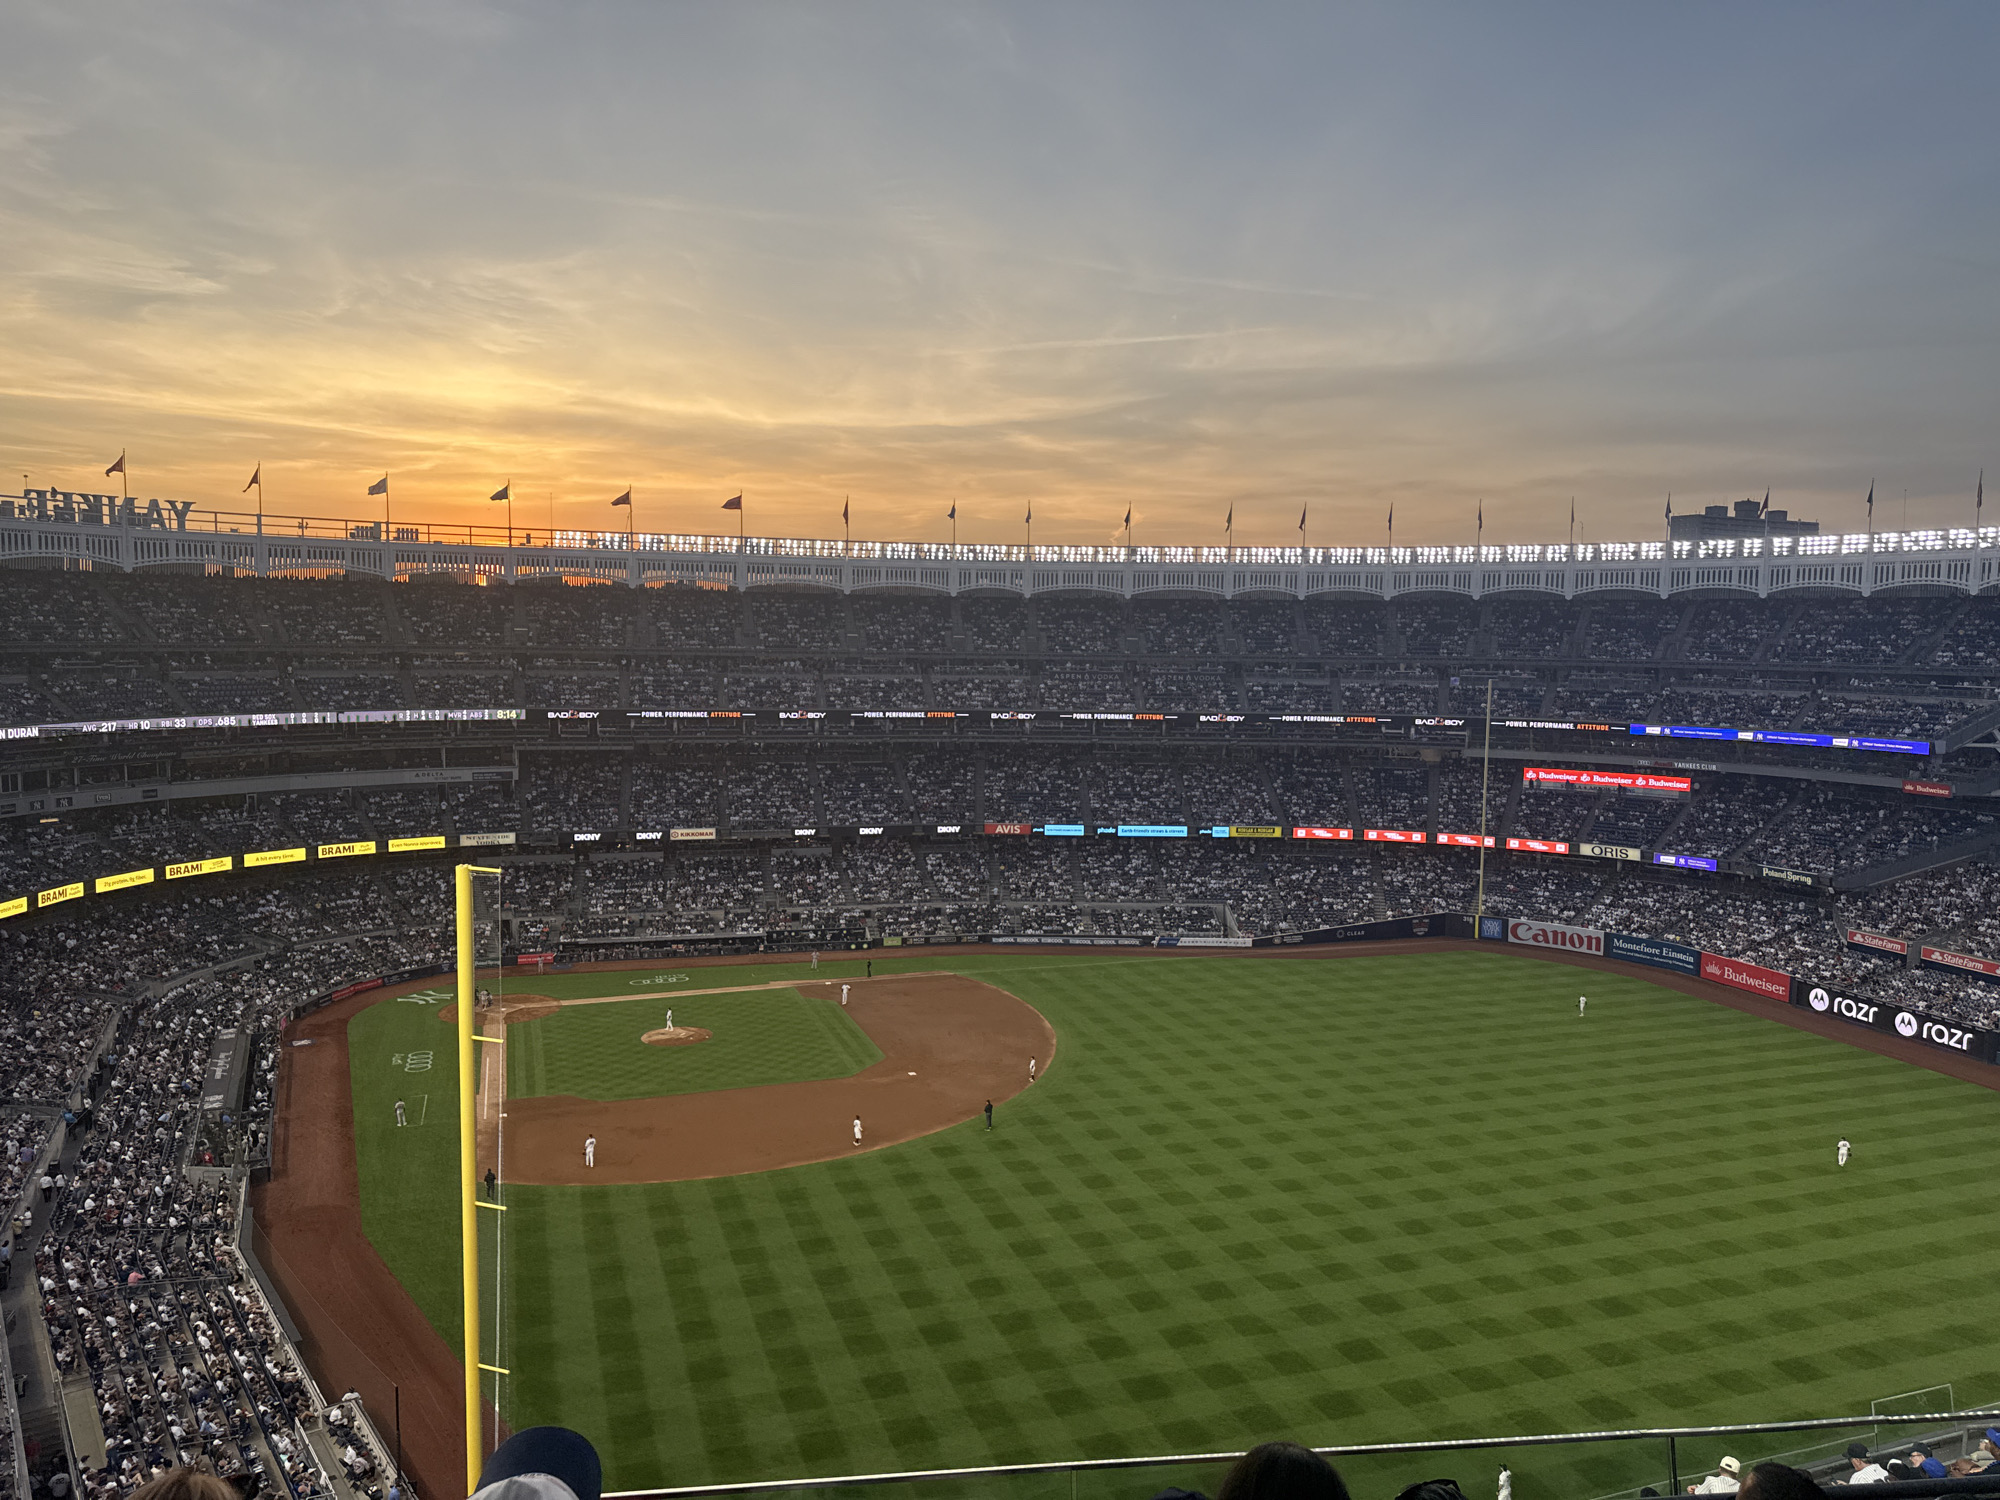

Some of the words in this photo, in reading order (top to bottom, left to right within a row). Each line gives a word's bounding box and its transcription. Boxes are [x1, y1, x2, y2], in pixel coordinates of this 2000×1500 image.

[215, 716, 236, 726] .685
[497, 710, 516, 719] 8:14
[99, 722, 116, 732] .217
[140, 720, 150, 730] 10
[174, 718, 186, 728] 33
[8, 726, 39, 739] DURAN
[1539, 771, 1577, 781] Budweiser
[1593, 775, 1633, 785] Budweiser
[1648, 778, 1688, 788] Budweiser
[1916, 785, 1949, 794] Budweiser
[995, 824, 1020, 834] AVIS
[322, 845, 354, 856] BRAMI
[1591, 846, 1629, 858] ORIS
[169, 863, 203, 876] BRAMI
[1762, 867, 1786, 880] Poland
[1787, 871, 1812, 885] Spring
[41, 888, 67, 904] BRAMI
[1510, 922, 1601, 952] Canon
[1613, 938, 1660, 954] Montefiore
[1662, 948, 1694, 962] Einstein
[1724, 966, 1785, 995] Budweiser
[1833, 997, 1878, 1023] razr
[1922, 1022, 1974, 1050] razr
